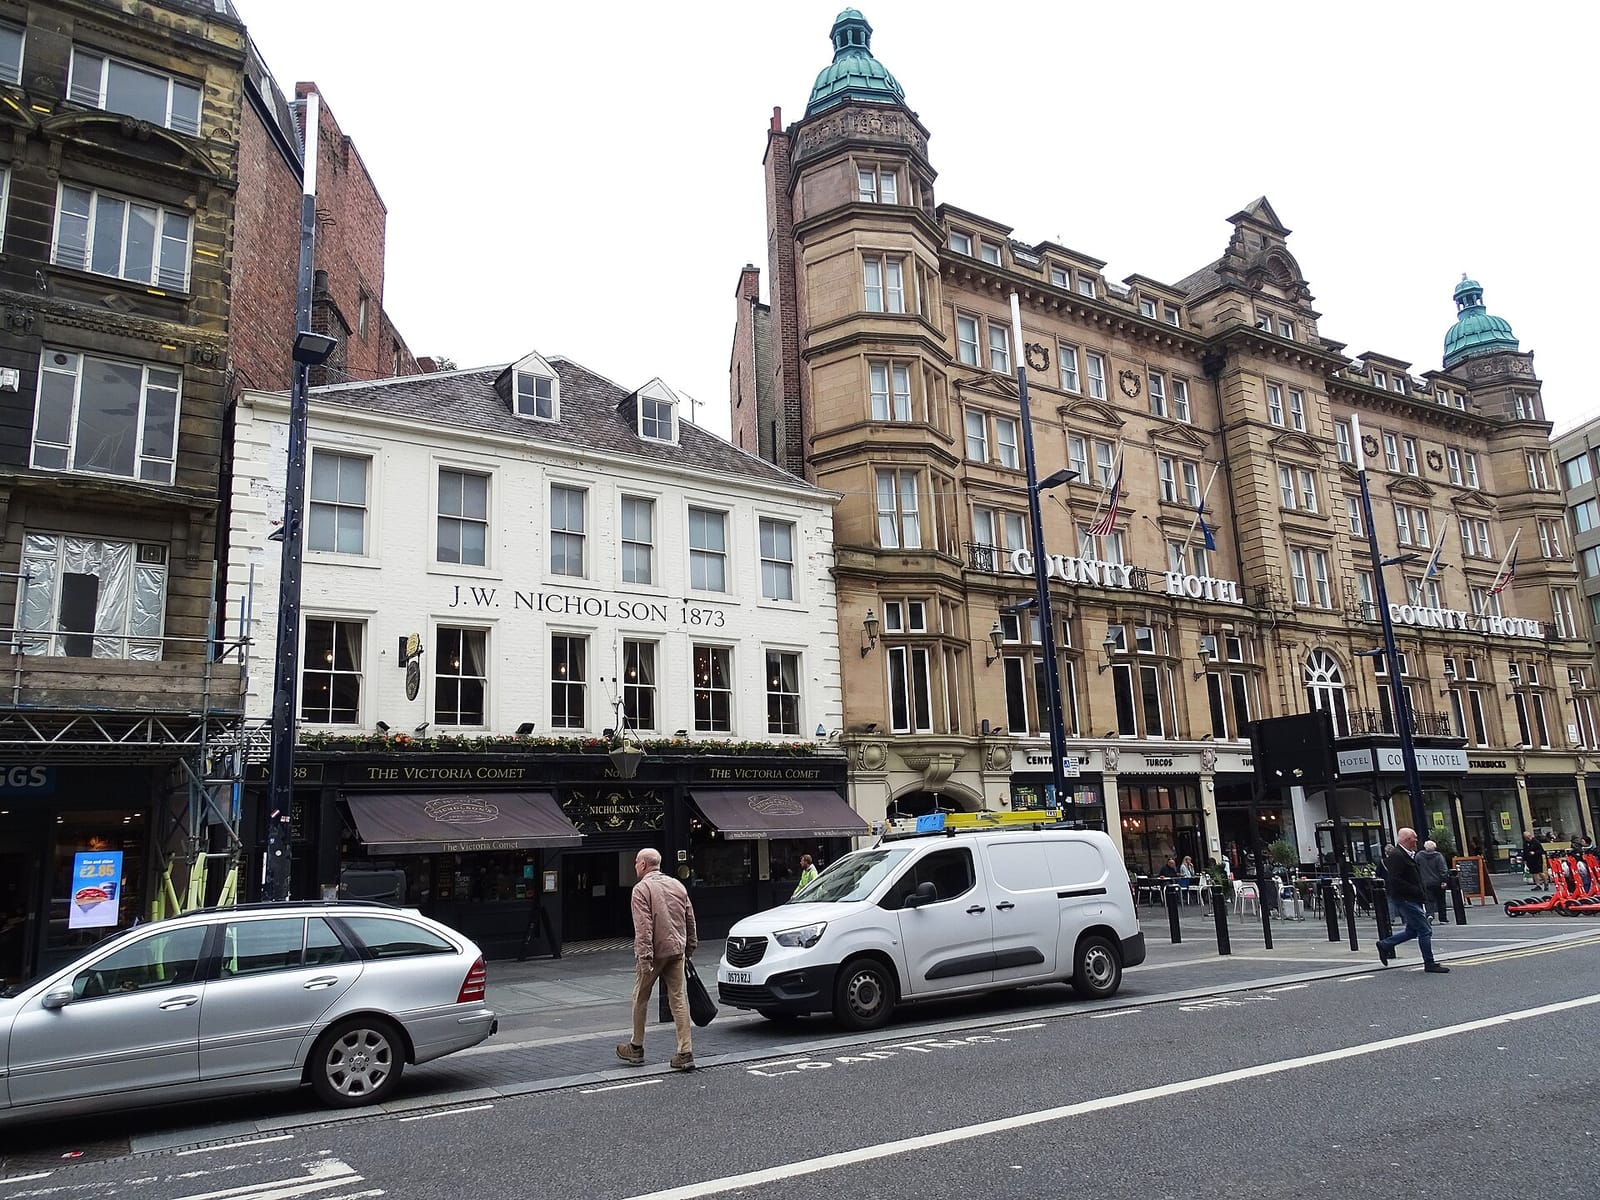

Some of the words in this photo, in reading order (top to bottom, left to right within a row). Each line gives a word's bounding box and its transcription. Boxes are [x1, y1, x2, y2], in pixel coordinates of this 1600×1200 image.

[1163, 571, 1243, 604] HOTEL
[449, 585, 500, 608] J.W.
[514, 590, 668, 622] NICHOLSON
[680, 607, 726, 628] 1873
[1388, 603, 1468, 630] COUNTY
[1486, 616, 1545, 639] HOTEL
[1146, 758, 1173, 767] TURCOS
[1339, 757, 1369, 767] HOTEL
[1387, 754, 1428, 766] COTY
[1432, 755, 1461, 766] HOTEL
[1469, 760, 1507, 769] STARBUCKS
[367, 767, 399, 780] THE
[403, 767, 473, 779] VICTORIA
[476, 767, 526, 779] COMET
[709, 768, 731, 779] THE
[734, 768, 783, 779] VICTORIA
[785, 769, 820, 779] COMET
[442, 843, 458, 852] The
[459, 841, 491, 851] Victoria
[492, 840, 519, 850] Comet
